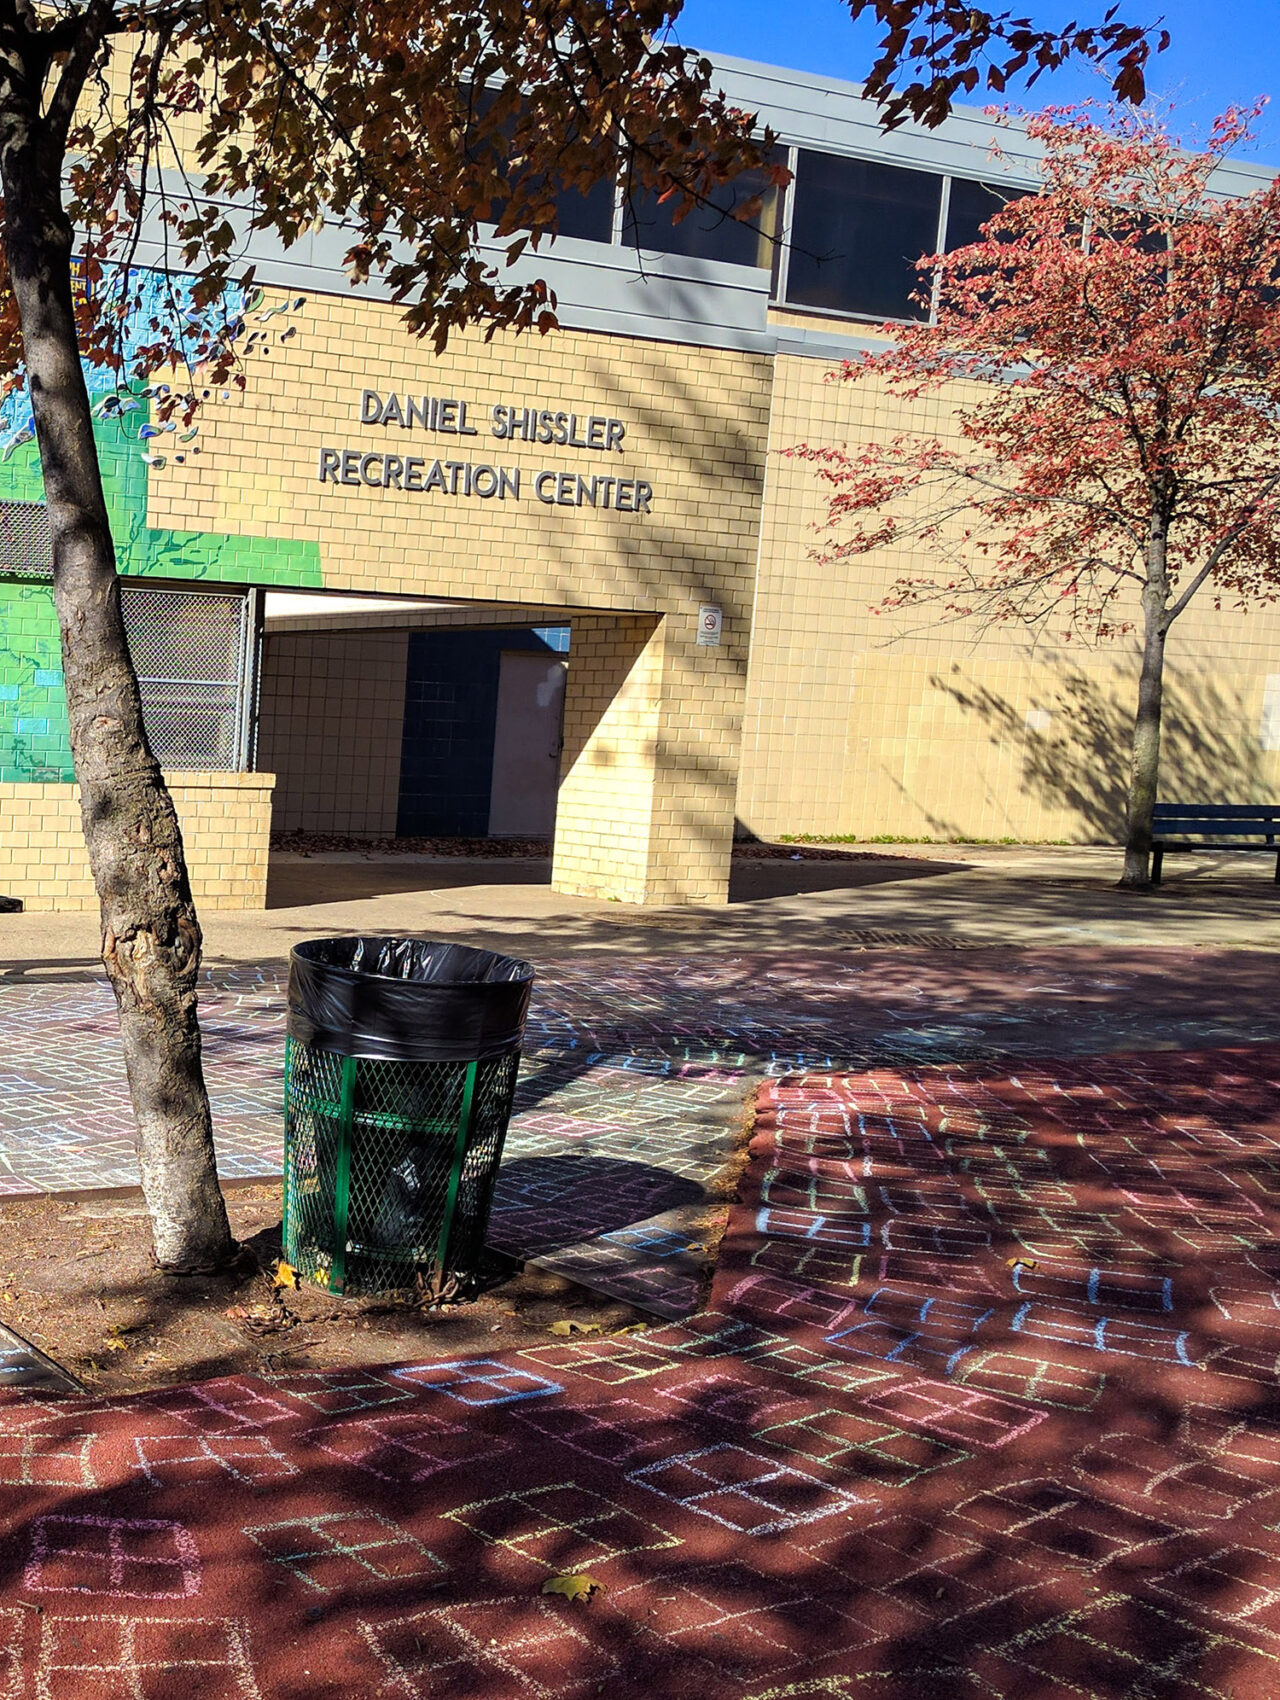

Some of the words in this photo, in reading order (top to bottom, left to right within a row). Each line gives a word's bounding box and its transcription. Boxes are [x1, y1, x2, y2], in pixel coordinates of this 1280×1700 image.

[361, 389, 477, 436] DANIEL
[491, 404, 625, 453] SHISSLER
[319, 448, 520, 500] RECREATION
[534, 470, 653, 513] CENTER
